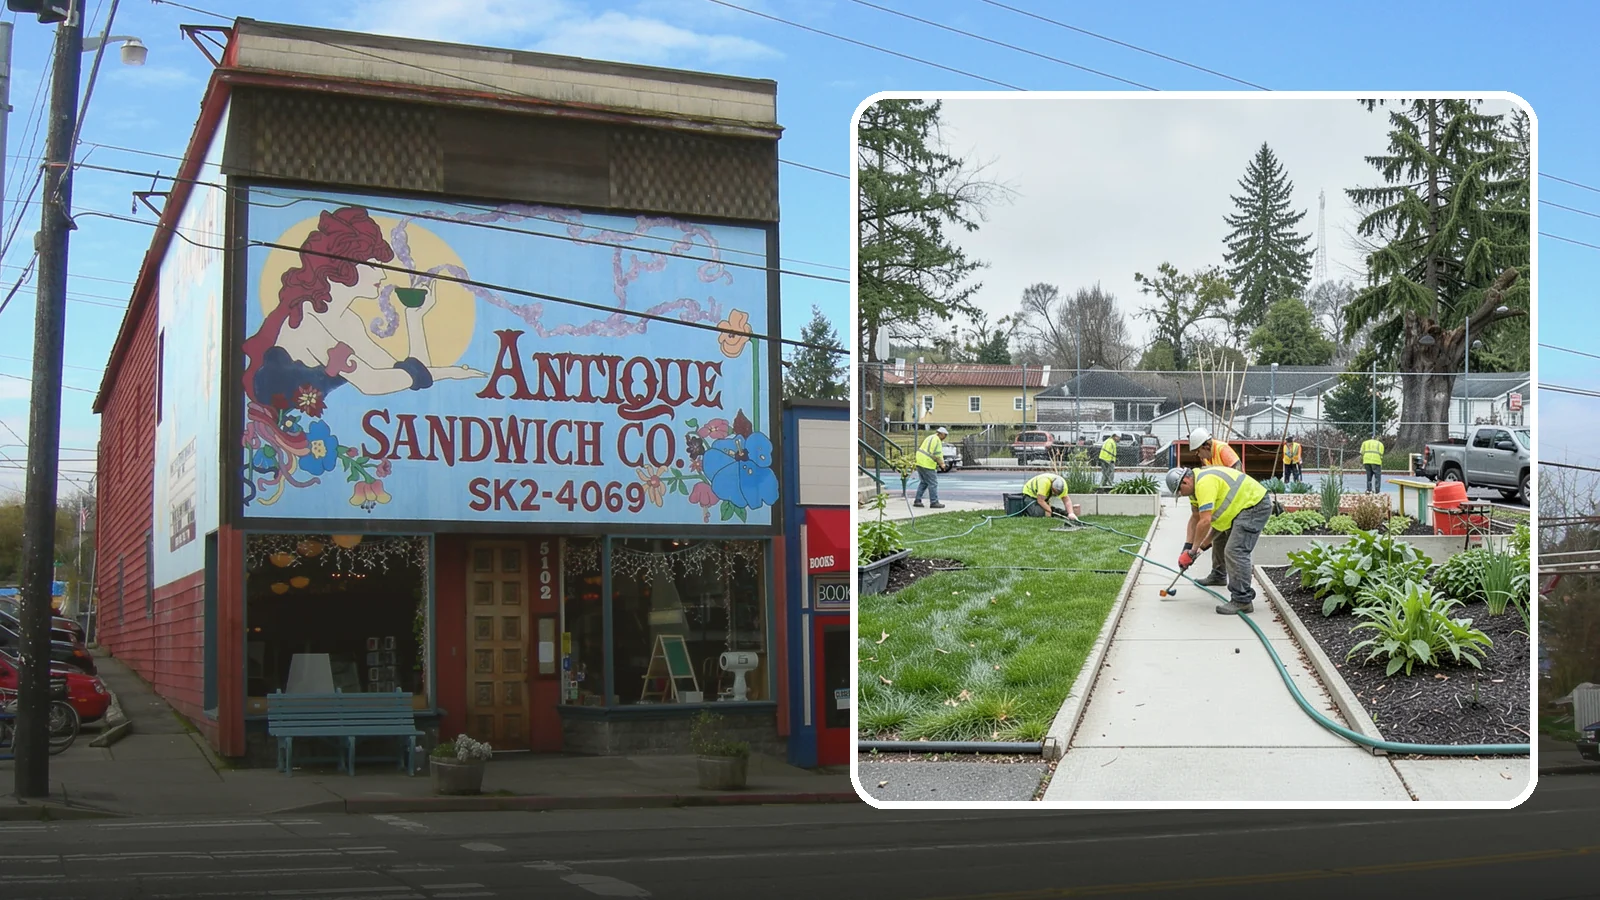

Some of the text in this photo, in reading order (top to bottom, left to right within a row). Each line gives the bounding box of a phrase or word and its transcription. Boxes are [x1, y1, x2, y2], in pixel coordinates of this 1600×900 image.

[475, 329, 724, 421] ANTIQUE
[360, 408, 685, 469] SANDWICH CO.
[468, 477, 646, 513] SK2-4069
[540, 541, 551, 600] 5102
[810, 555, 835, 569] BOOKS
